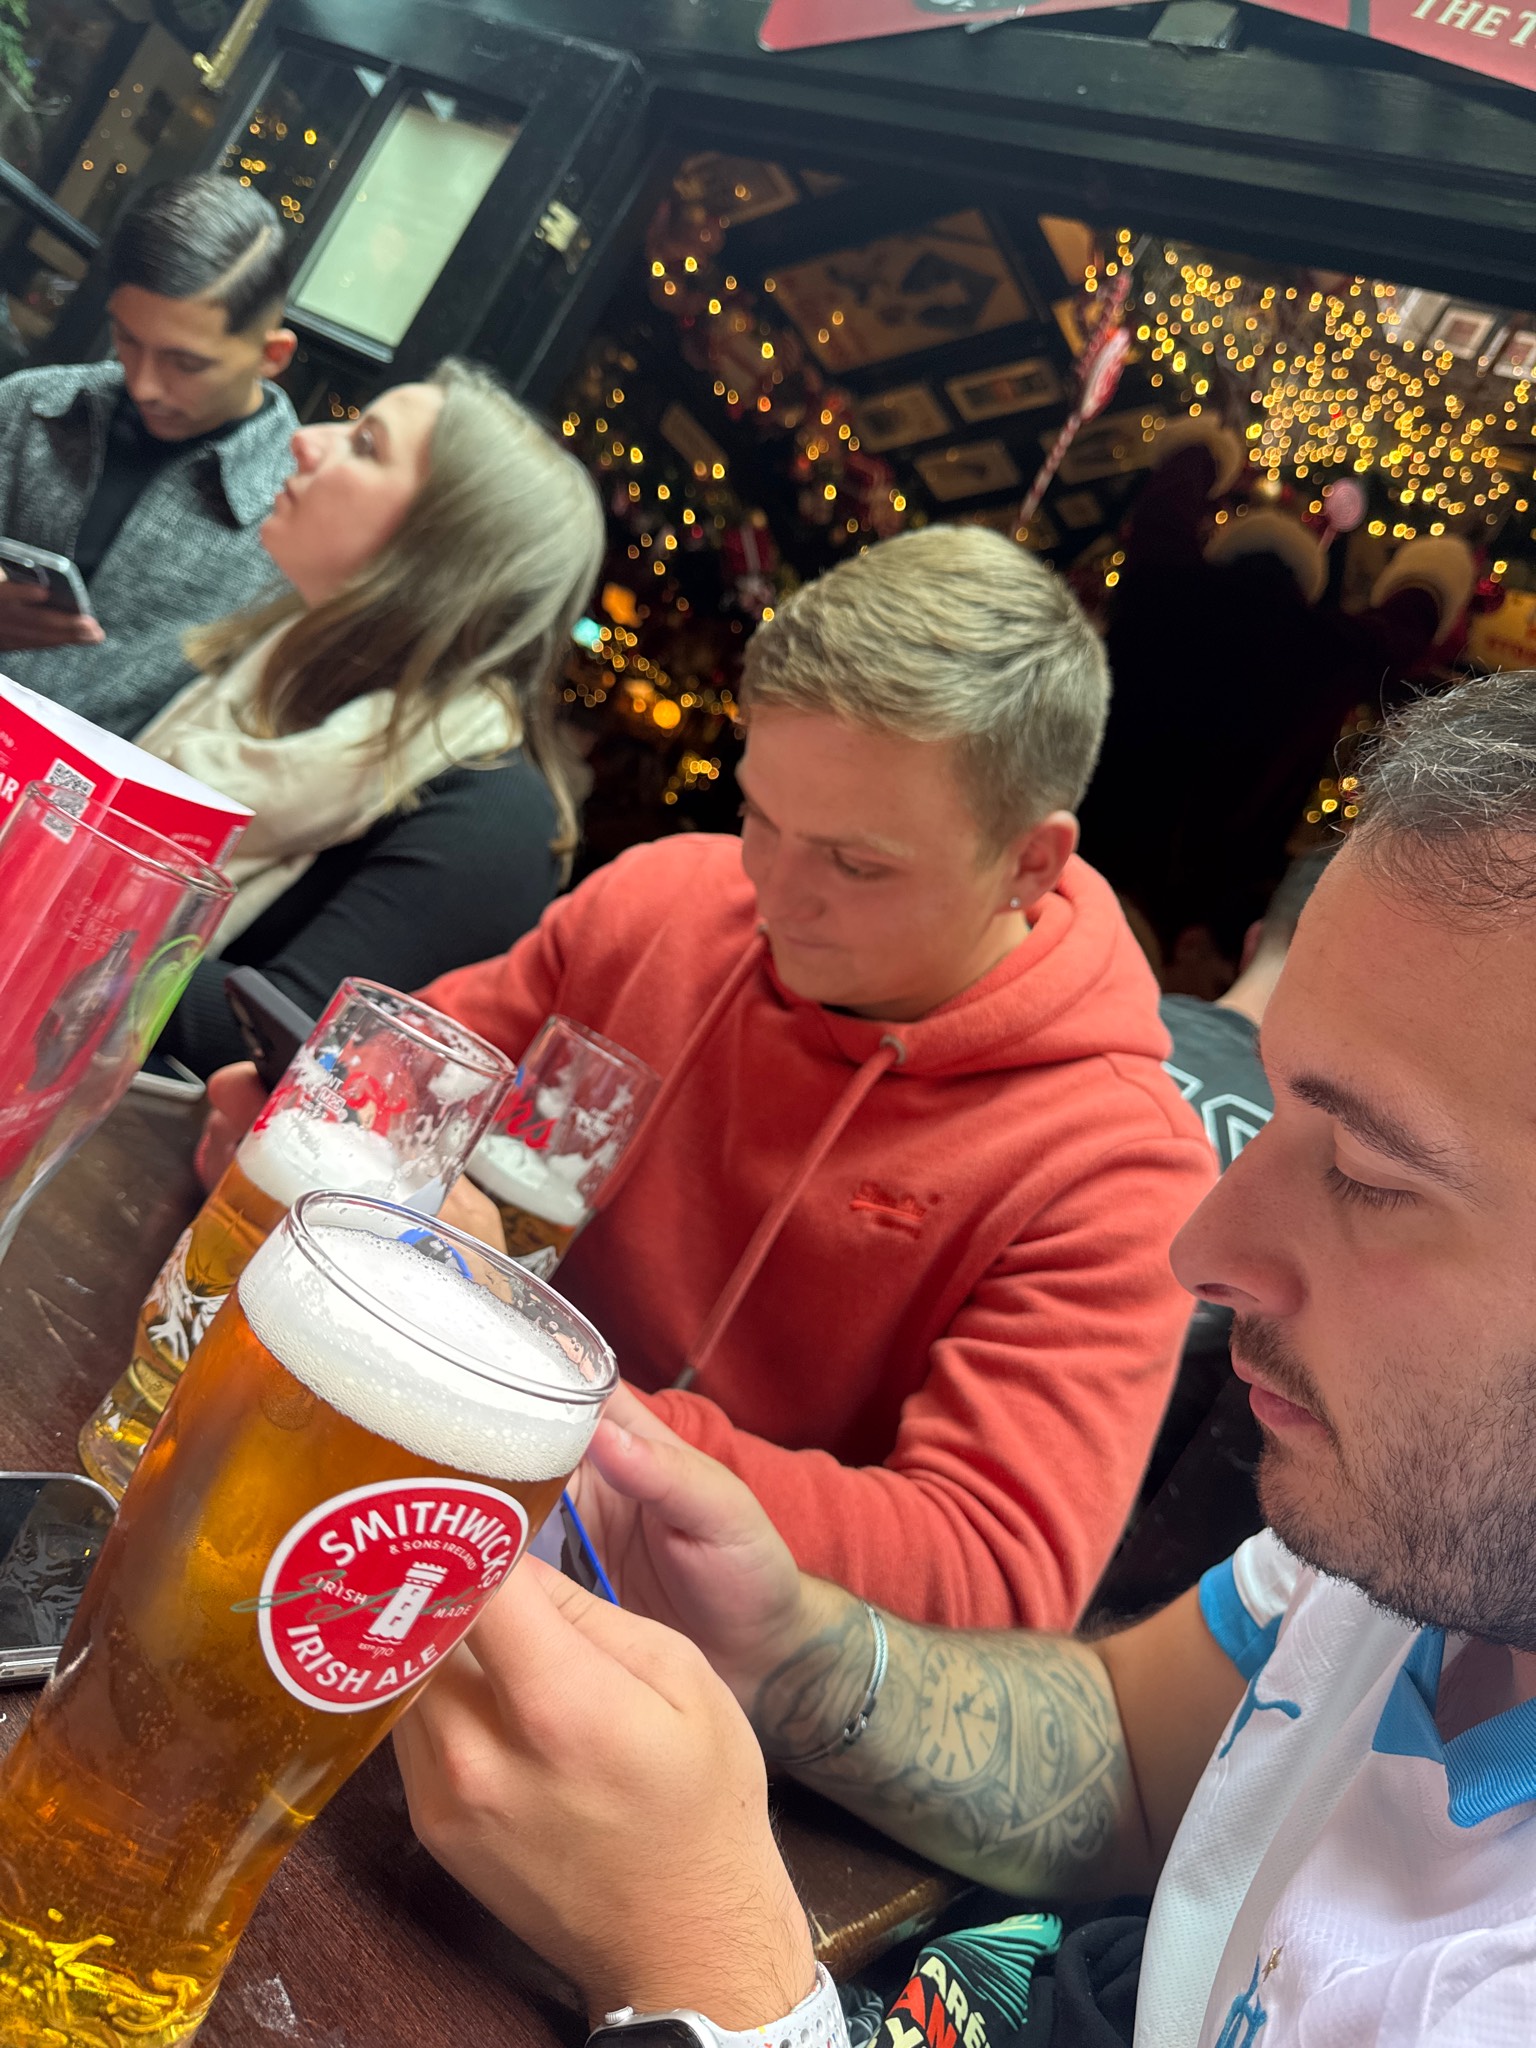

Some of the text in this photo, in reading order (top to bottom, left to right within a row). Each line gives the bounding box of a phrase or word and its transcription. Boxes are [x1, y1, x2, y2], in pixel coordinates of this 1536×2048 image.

[402, 1540, 441, 1551] SONS
[442, 1542, 478, 1570] IRELAND
[315, 1576, 368, 1605] IRISH
[432, 1604, 473, 1619] MADE
[286, 1624, 438, 1694] IRISH ALE
